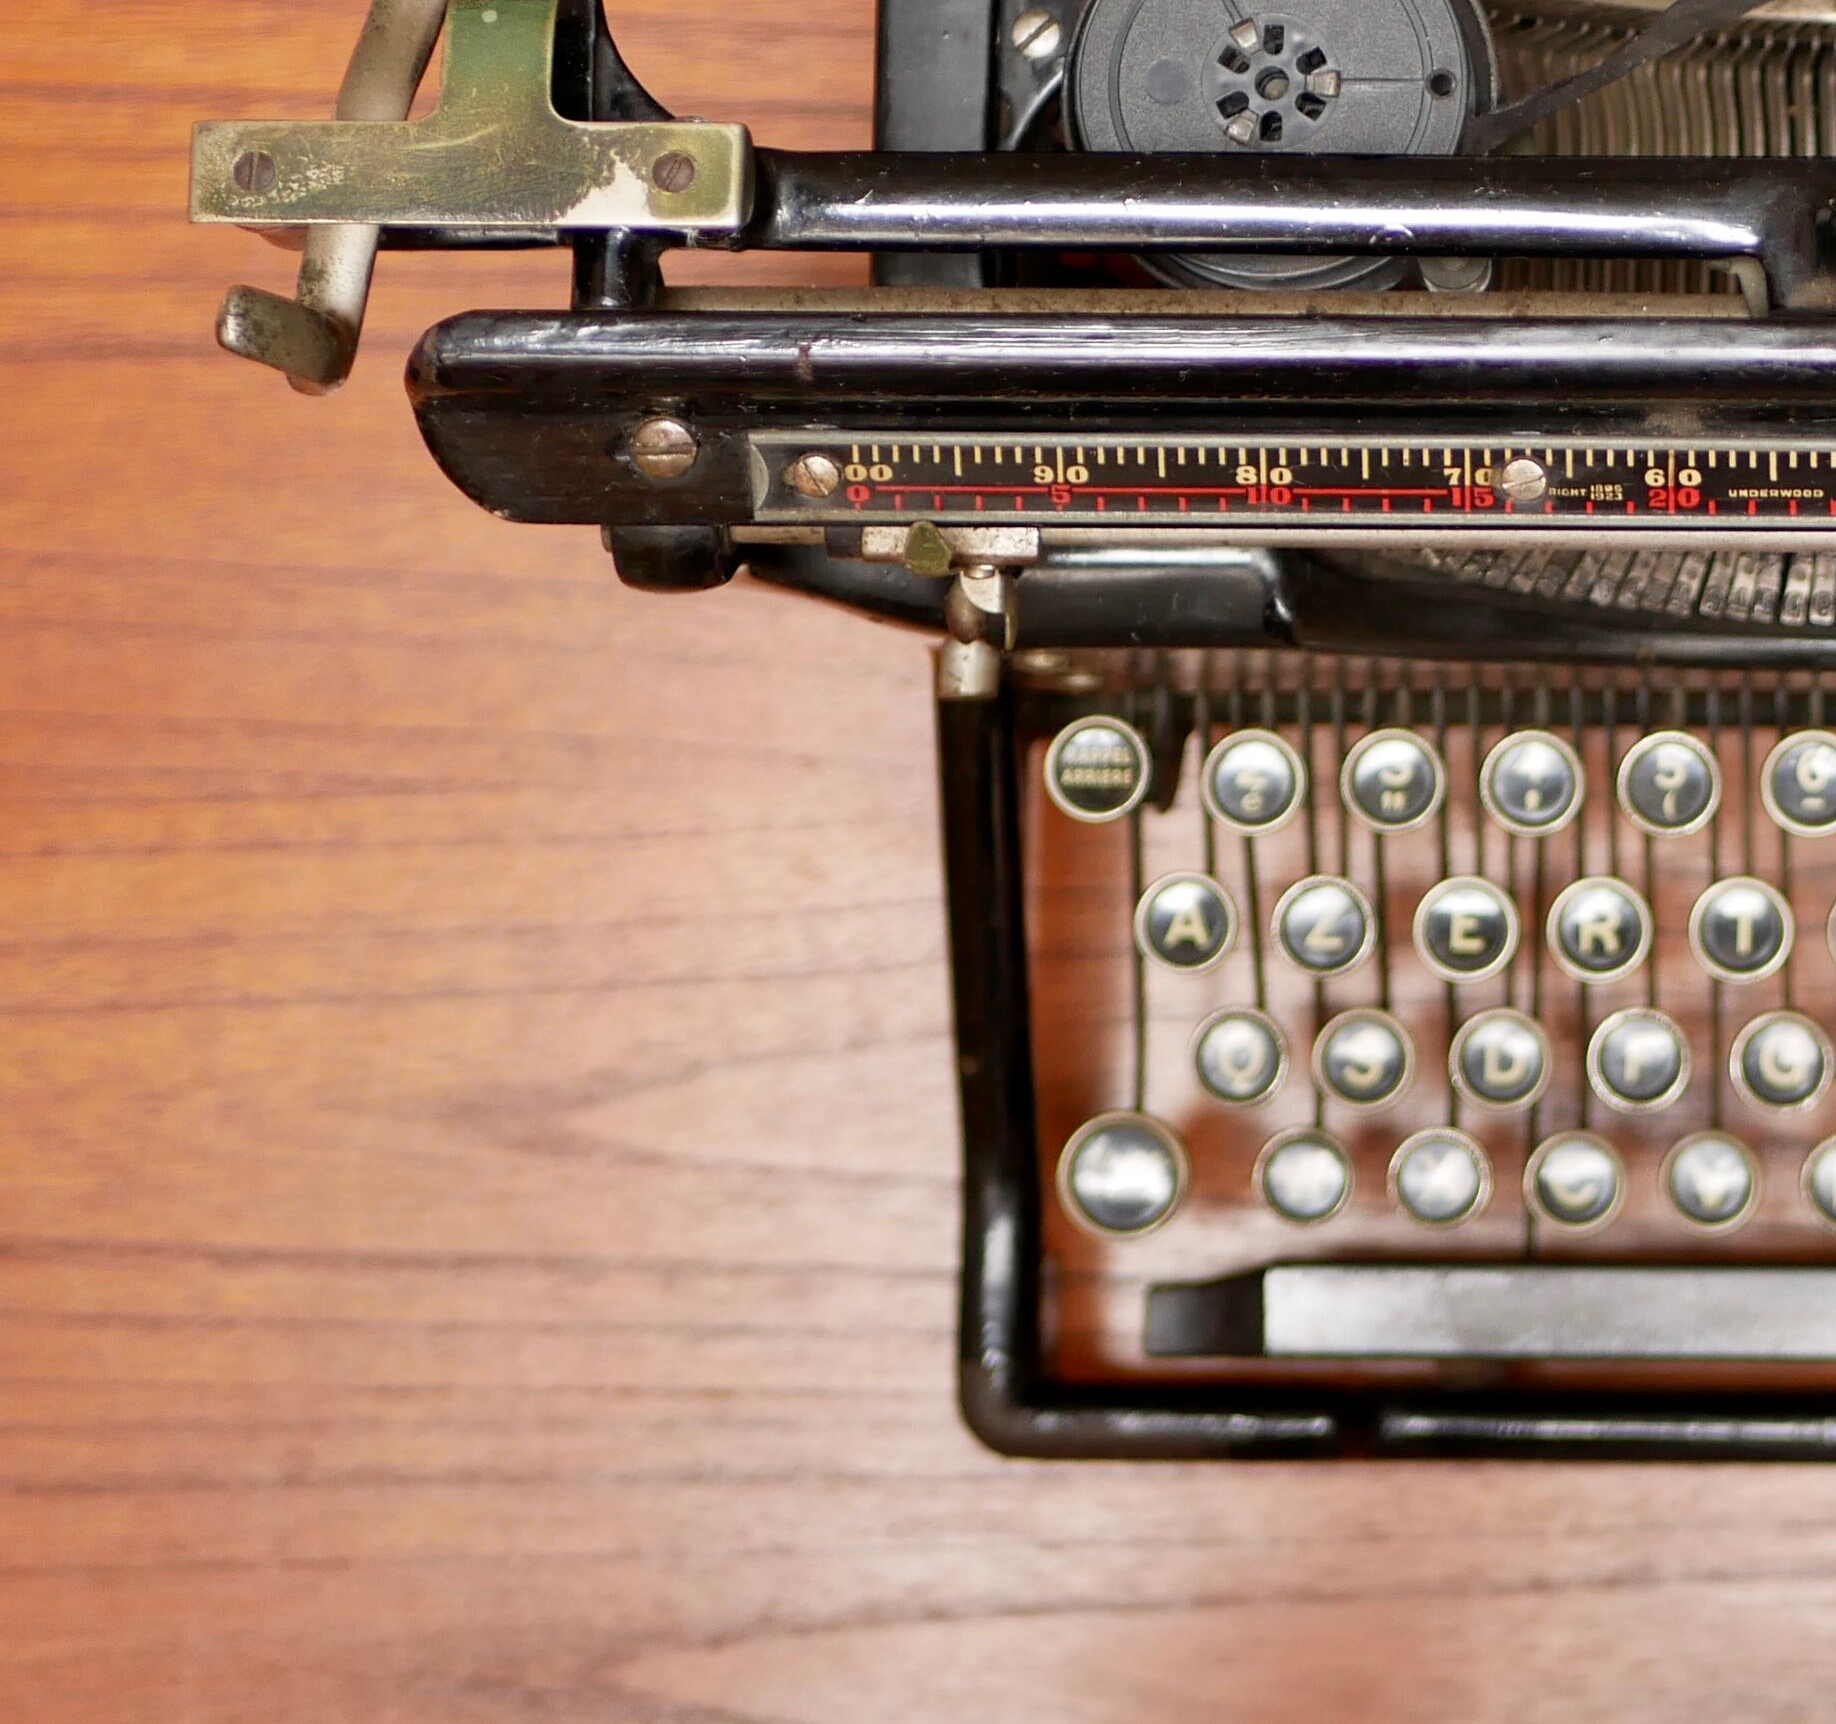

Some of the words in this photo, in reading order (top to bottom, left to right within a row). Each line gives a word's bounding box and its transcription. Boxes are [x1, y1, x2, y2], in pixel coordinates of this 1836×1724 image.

[844, 463, 892, 482] 00
[1034, 466, 1089, 484] 90
[1235, 466, 1293, 485] 80
[1644, 468, 1702, 487] 60
[1548, 487, 1587, 497] RIGHT
[1728, 487, 1825, 498] UNDERWOOD
[846, 484, 870, 502] 0
[1051, 484, 1072, 503] 5
[1247, 486, 1293, 505] 10
[1451, 486, 1495, 507] 15
[1648, 488, 1701, 508] 20
[1163, 908, 1211, 950] A
[1448, 911, 1486, 955] E
[1578, 916, 1622, 955] R
[1483, 1040, 1527, 1085] D
[1758, 1031, 1806, 1088] G
